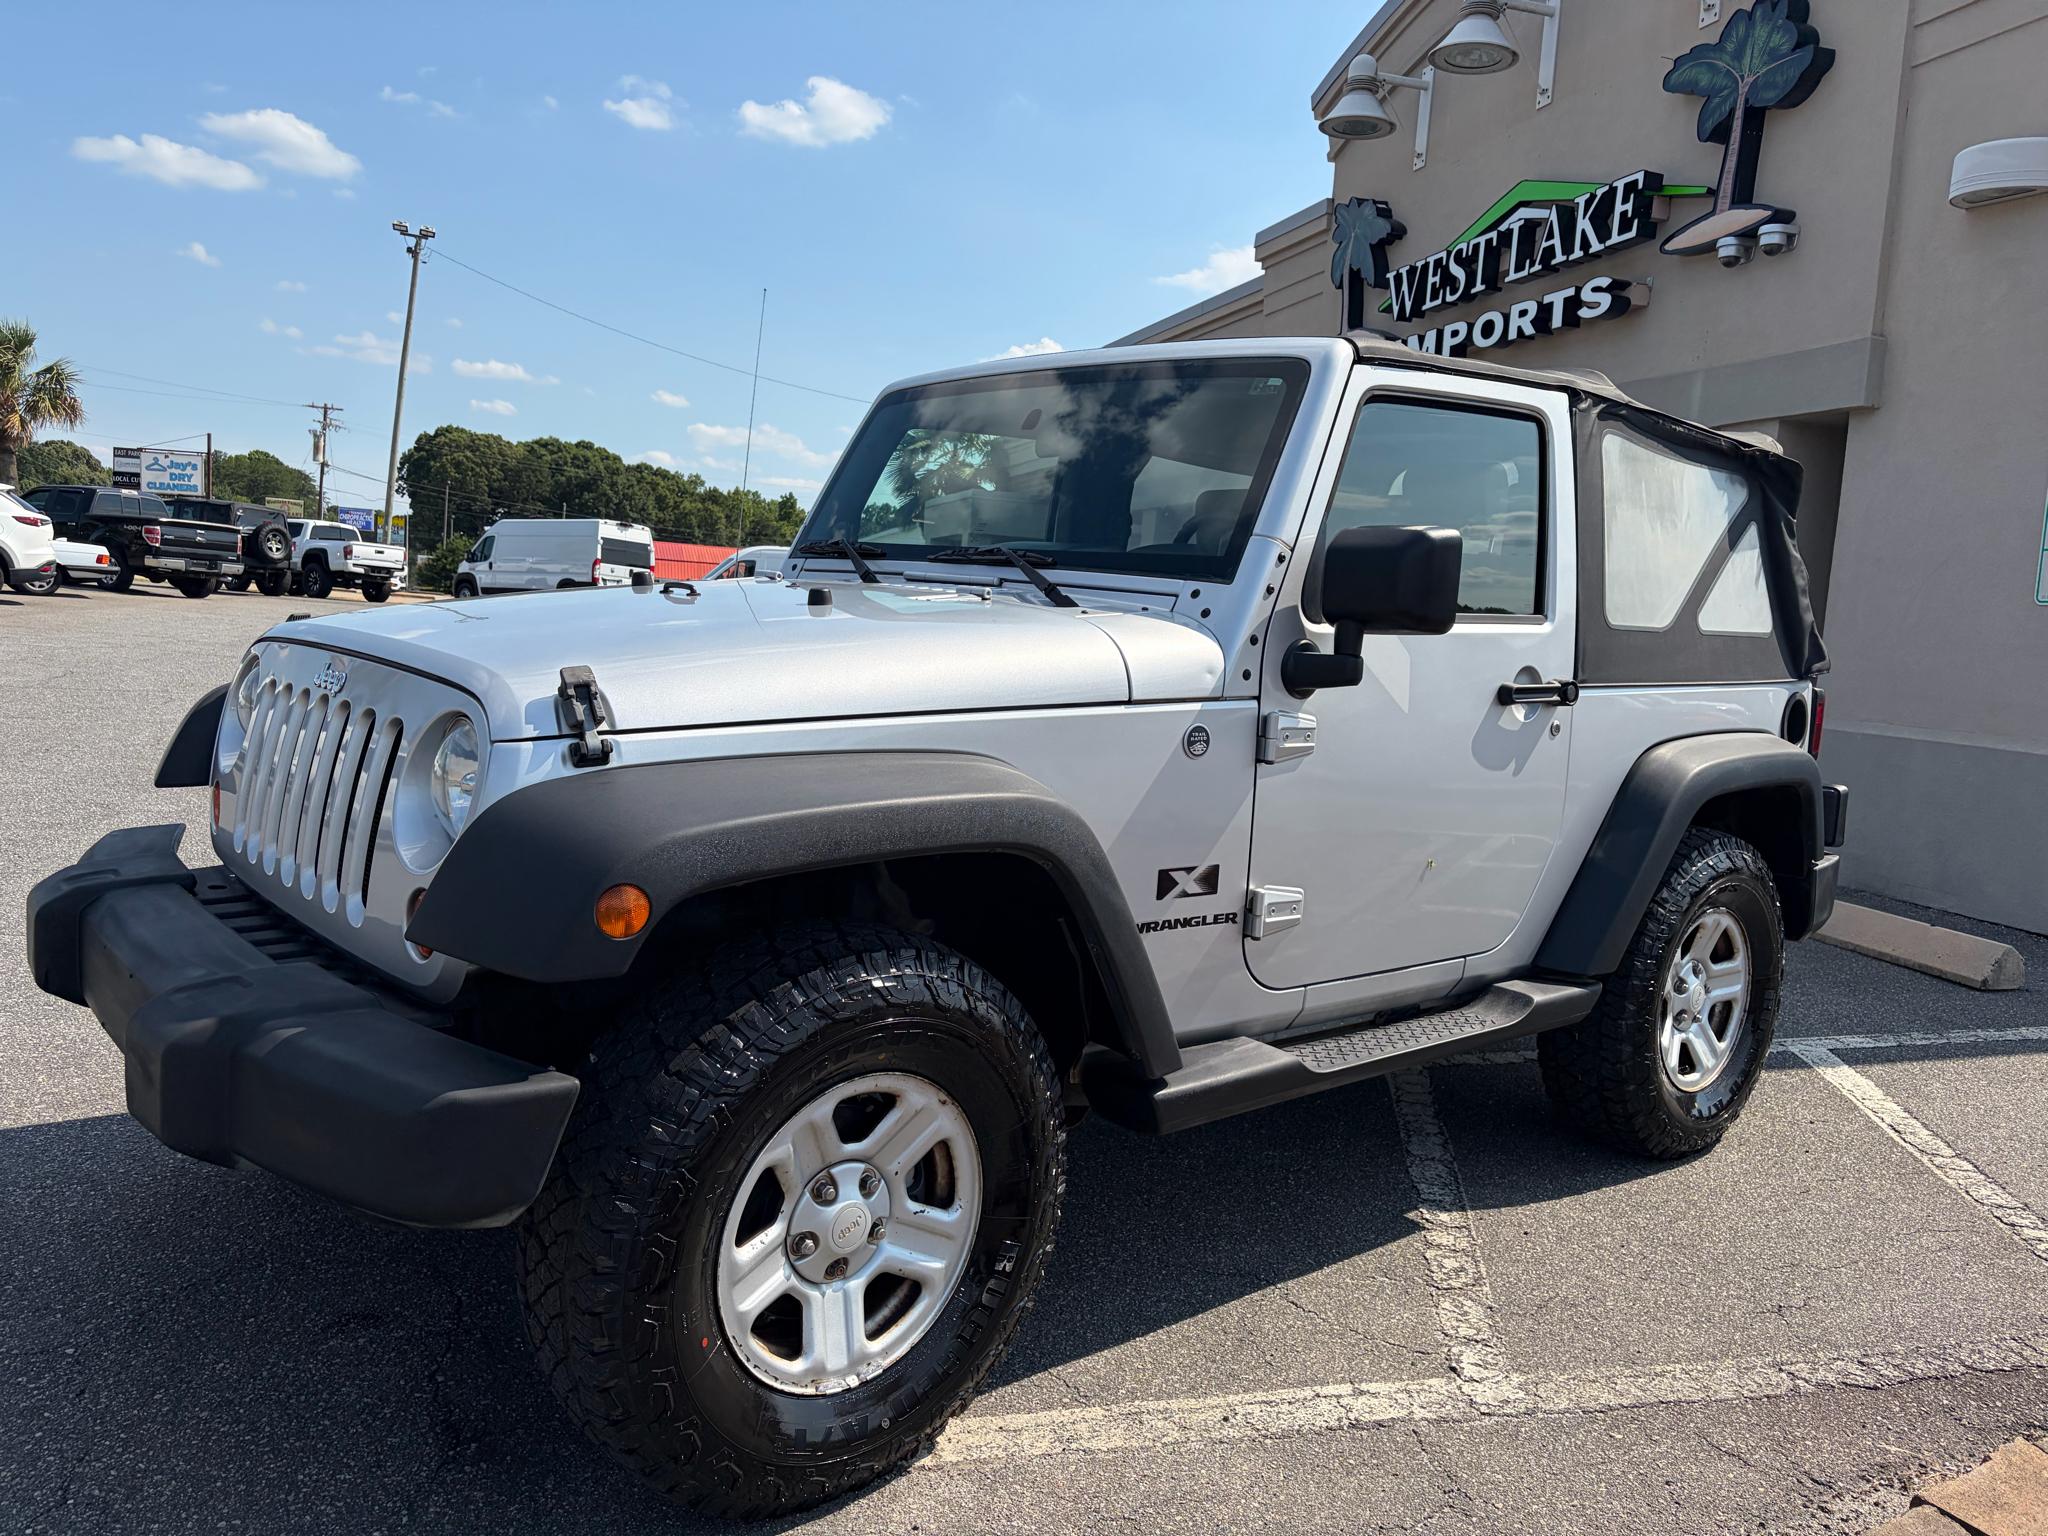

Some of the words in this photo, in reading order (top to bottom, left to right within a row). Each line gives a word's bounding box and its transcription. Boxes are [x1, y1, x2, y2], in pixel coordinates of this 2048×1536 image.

[1405, 276, 1613, 357] MPORTS
[166, 460, 198, 472] Jay's
[112, 475, 129, 483] LOCAL
[169, 472, 194, 483] DRY
[146, 481, 199, 493] CLEANERS
[838, 1215, 862, 1241] Jeep
